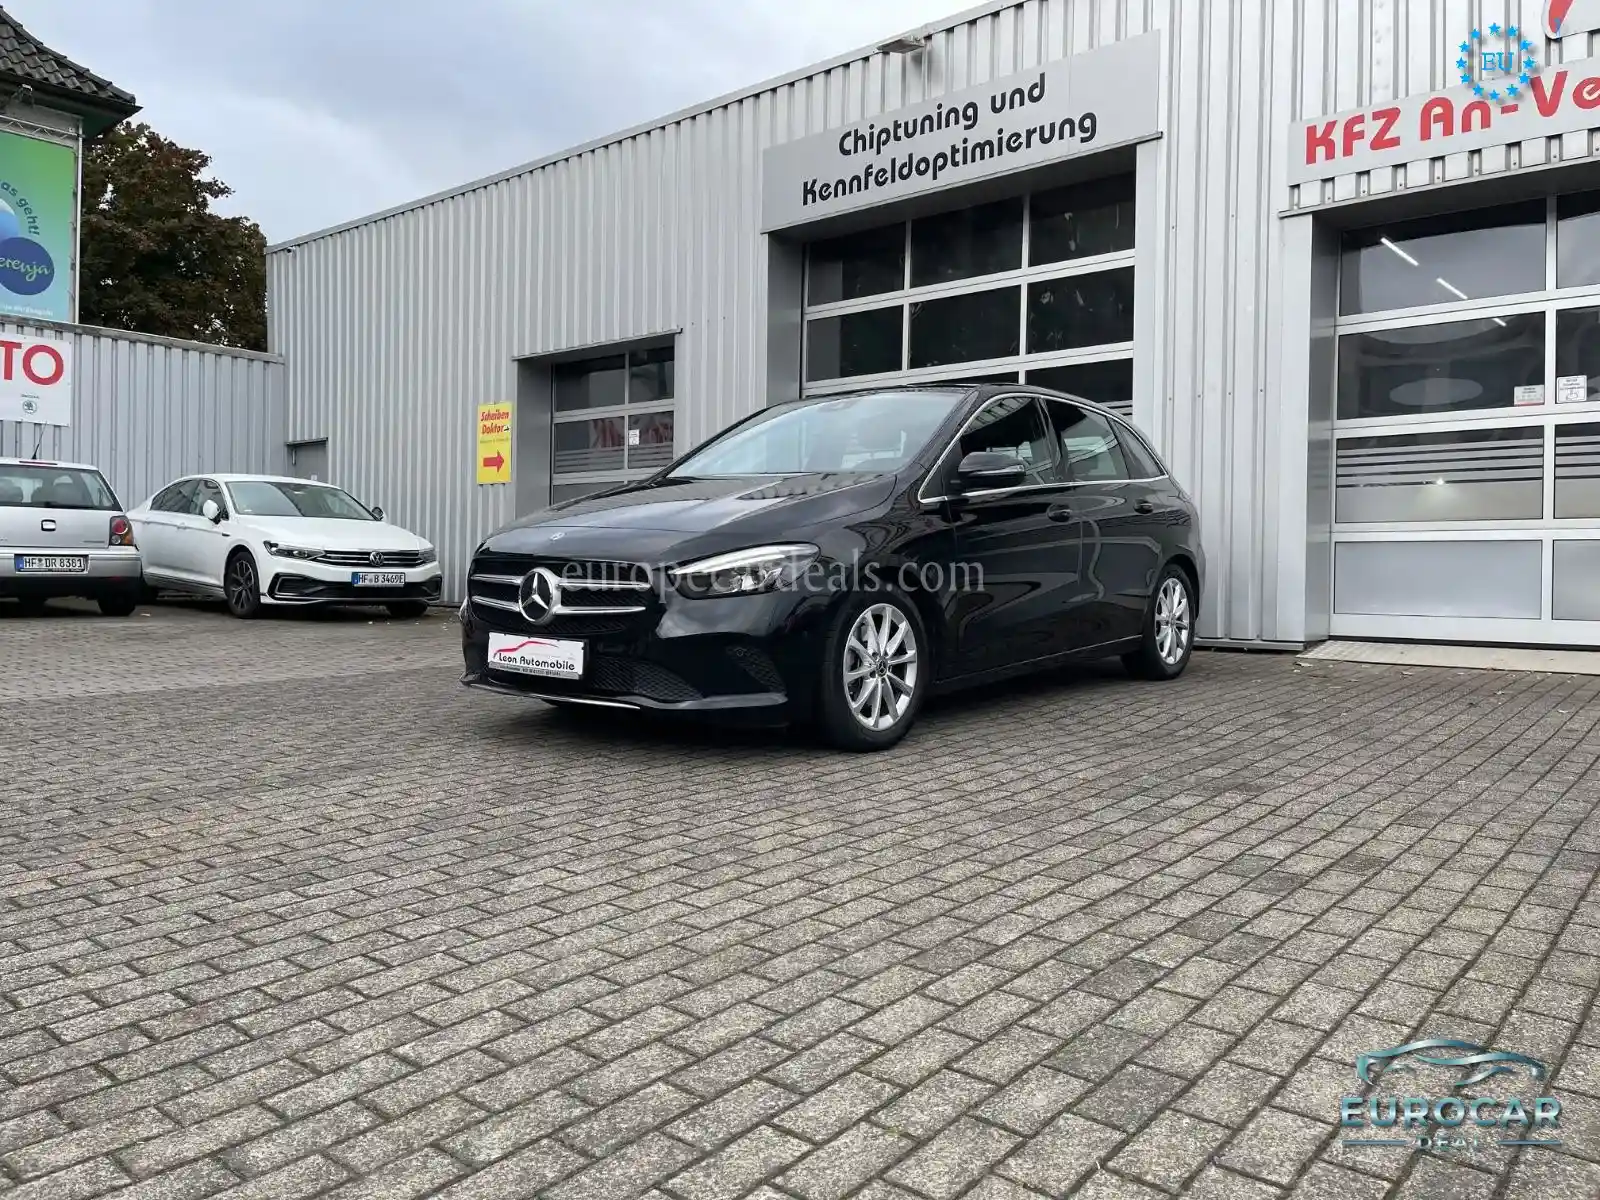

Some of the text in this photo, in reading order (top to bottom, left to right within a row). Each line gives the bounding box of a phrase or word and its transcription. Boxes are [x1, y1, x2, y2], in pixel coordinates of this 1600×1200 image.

[838, 72, 1046, 156] Chiptuning und
[1305, 106, 1401, 165] KFZ
[802, 111, 1098, 206] Kennfeldoptimierung
[0, 340, 64, 386] TO
[481, 422, 504, 434] Doktor
[24, 557, 37, 568] HF
[45, 557, 57, 568] DR
[498, 652, 575, 670] Leon Automobile
